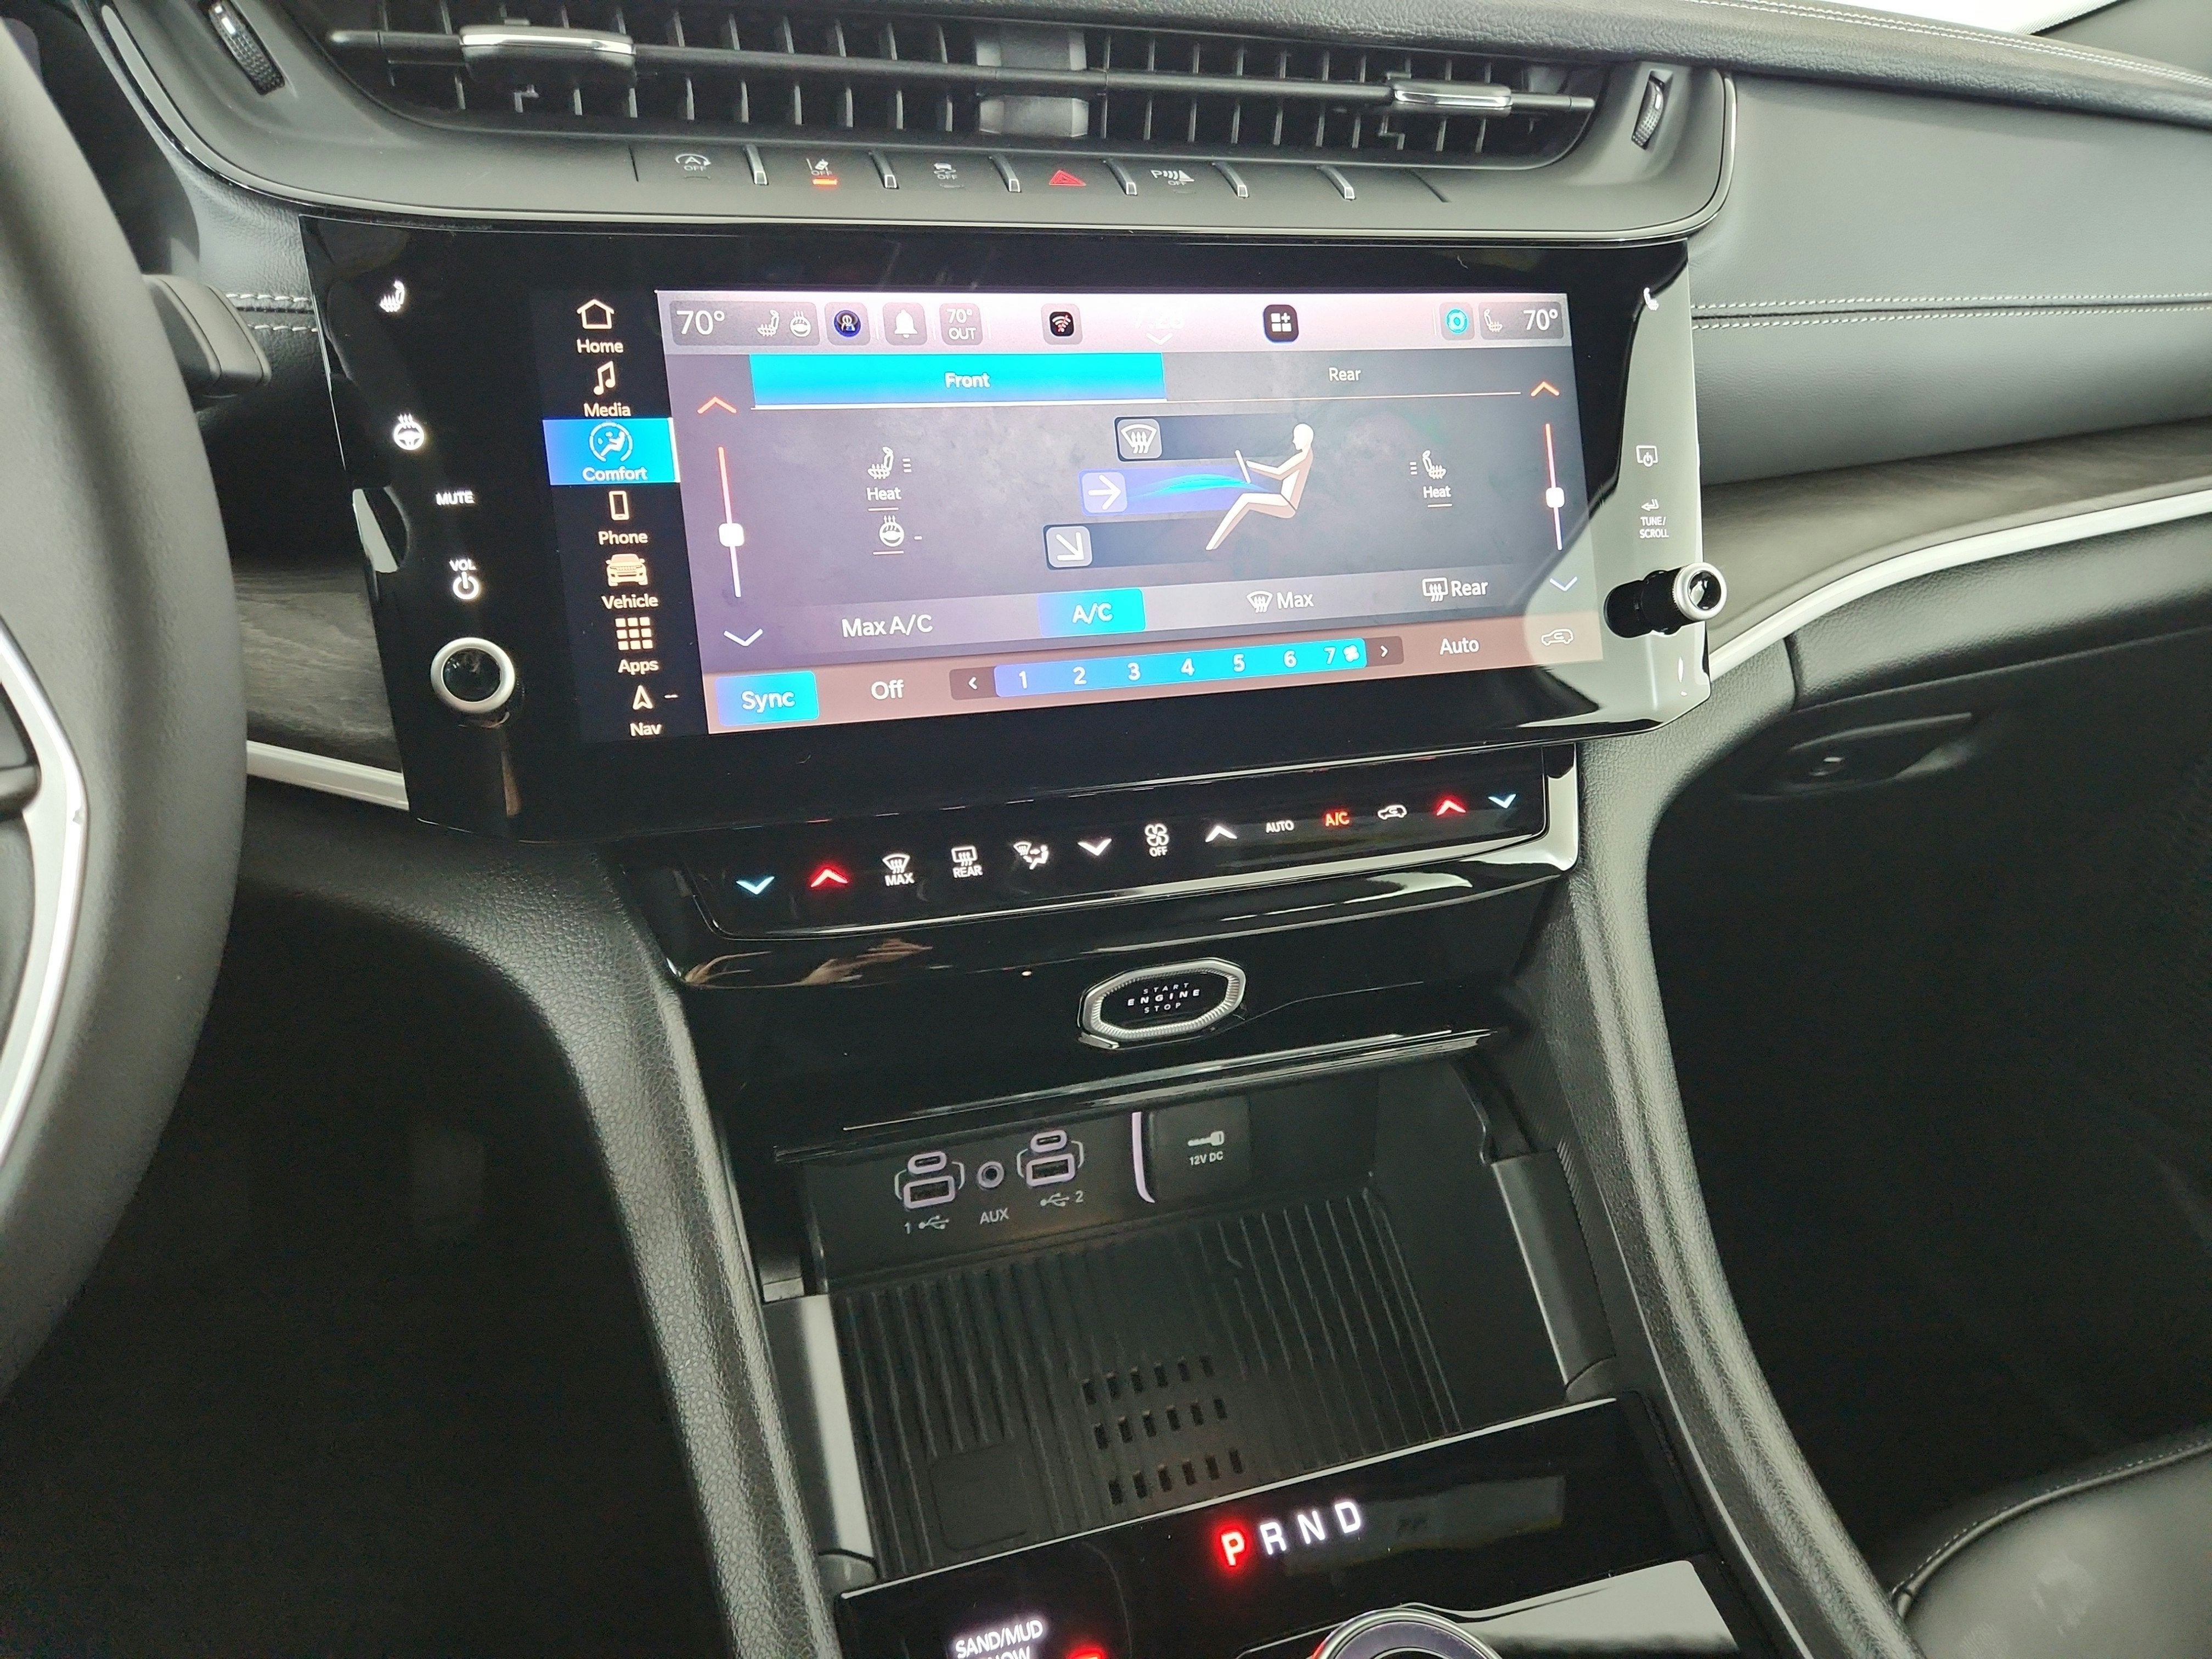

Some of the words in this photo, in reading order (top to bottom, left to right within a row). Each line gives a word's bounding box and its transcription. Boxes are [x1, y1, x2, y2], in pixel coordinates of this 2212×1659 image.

[948, 327, 977, 340] OUT
[577, 337, 624, 354] Home
[945, 371, 991, 388] Front
[1329, 367, 1362, 382] Rear
[584, 402, 631, 417] Media
[582, 465, 648, 483] Comfort
[436, 492, 474, 506] MUTE
[867, 487, 902, 501] Heat
[1423, 486, 1452, 500] Heat
[1640, 516, 1666, 526] TUNE/
[599, 529, 648, 545] Phone
[1639, 528, 1669, 539] SCROLL
[450, 559, 476, 572] VOL
[1451, 579, 1488, 597] Rear
[602, 592, 658, 609] Vehicle
[1277, 590, 1314, 610] Max
[1072, 602, 1114, 624] A/C
[842, 617, 887, 637] Max
[889, 614, 934, 635] A/C
[1439, 637, 1480, 656] Auto
[618, 657, 659, 675] Apps
[1018, 671, 1029, 689] 1
[1073, 667, 1087, 685] 2
[1127, 663, 1141, 680] 3
[1181, 659, 1195, 676] 4
[1232, 654, 1246, 672] 5
[1283, 651, 1297, 668] 6
[1324, 647, 1336, 664] 7
[871, 679, 904, 700] Off
[741, 690, 795, 711] Sync
[630, 721, 662, 737] Nav
[1266, 820, 1295, 833] AUTO
[1325, 811, 1350, 827] A/C
[1149, 846, 1168, 857] OFF
[952, 865, 983, 878] REAR
[884, 873, 915, 887] MAX
[1143, 983, 1189, 994] START
[1127, 989, 1200, 1006] ENGINE
[1144, 1002, 1181, 1013] STOP
[1189, 1154, 1207, 1166] 12V
[1209, 1152, 1224, 1163] DC
[1076, 1190, 1084, 1203] 2
[979, 1208, 1009, 1225] AUX
[904, 1222, 911, 1233] 1
[1222, 1532, 1244, 1566] P
[955, 1620, 1043, 1658] SAND/MUD
